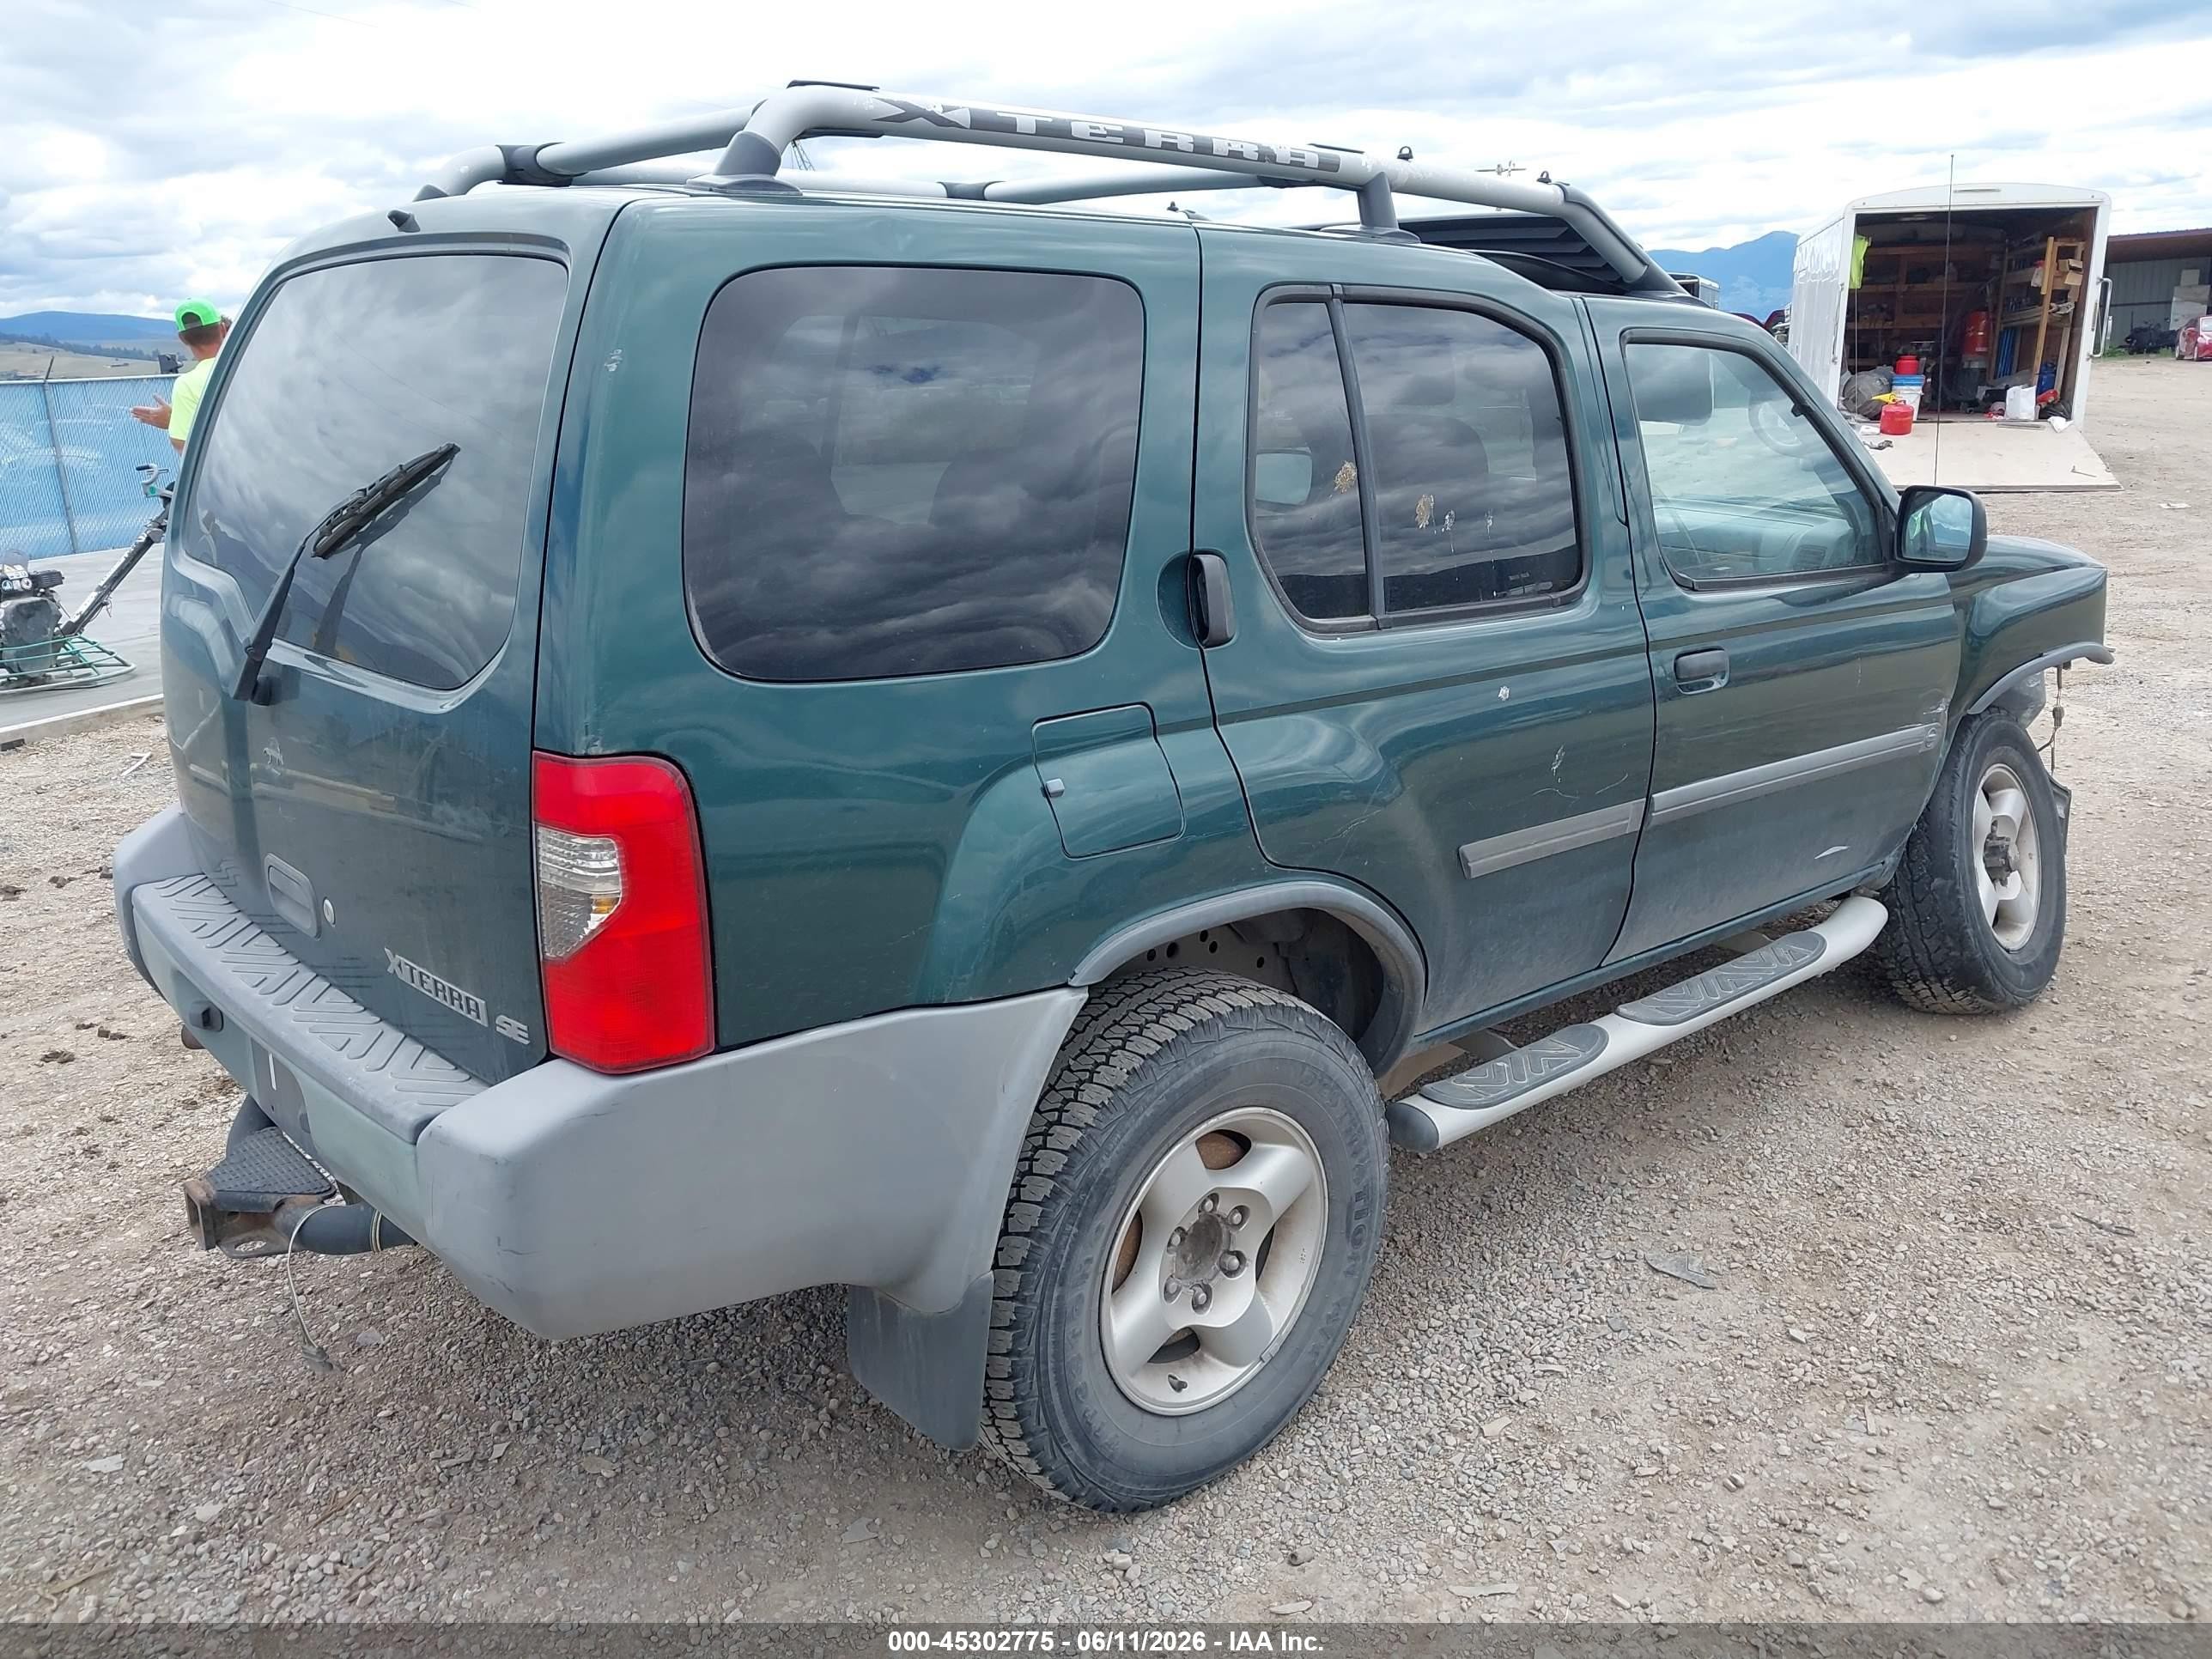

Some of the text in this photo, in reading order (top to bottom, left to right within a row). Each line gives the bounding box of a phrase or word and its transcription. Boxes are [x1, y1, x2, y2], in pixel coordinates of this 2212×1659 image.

[872, 96, 1320, 169] XTERRA
[384, 947, 531, 1045] XTERRA SE
